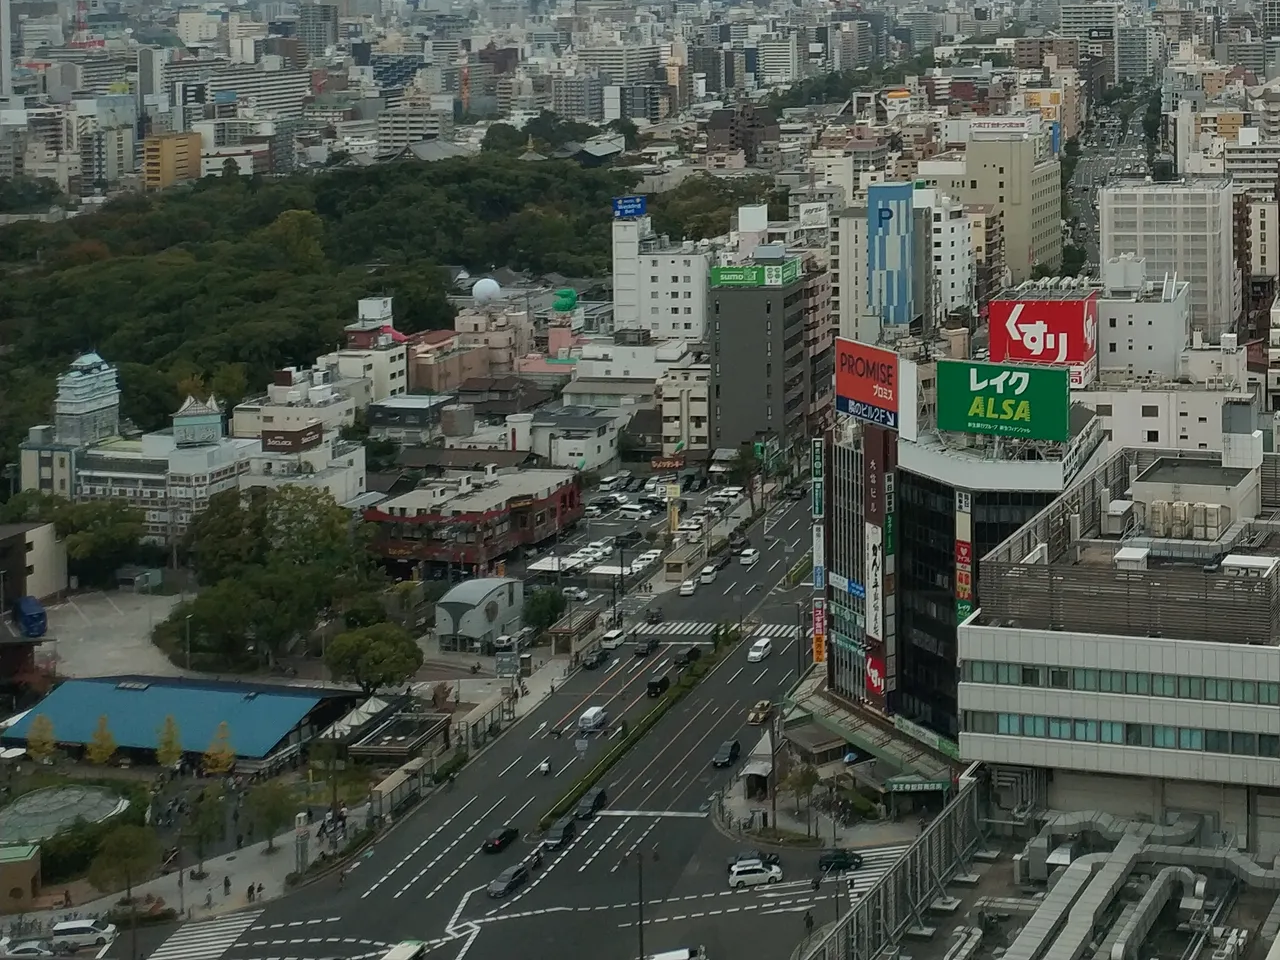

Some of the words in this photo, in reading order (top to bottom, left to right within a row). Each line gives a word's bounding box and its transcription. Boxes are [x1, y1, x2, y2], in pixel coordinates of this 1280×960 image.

[878, 208, 893, 227] P
[1005, 304, 1067, 362] くすり
[840, 352, 893, 386] PROMISE
[970, 368, 1030, 395] レイク
[873, 384, 893, 400] プロミス
[968, 396, 1030, 421] ALSA
